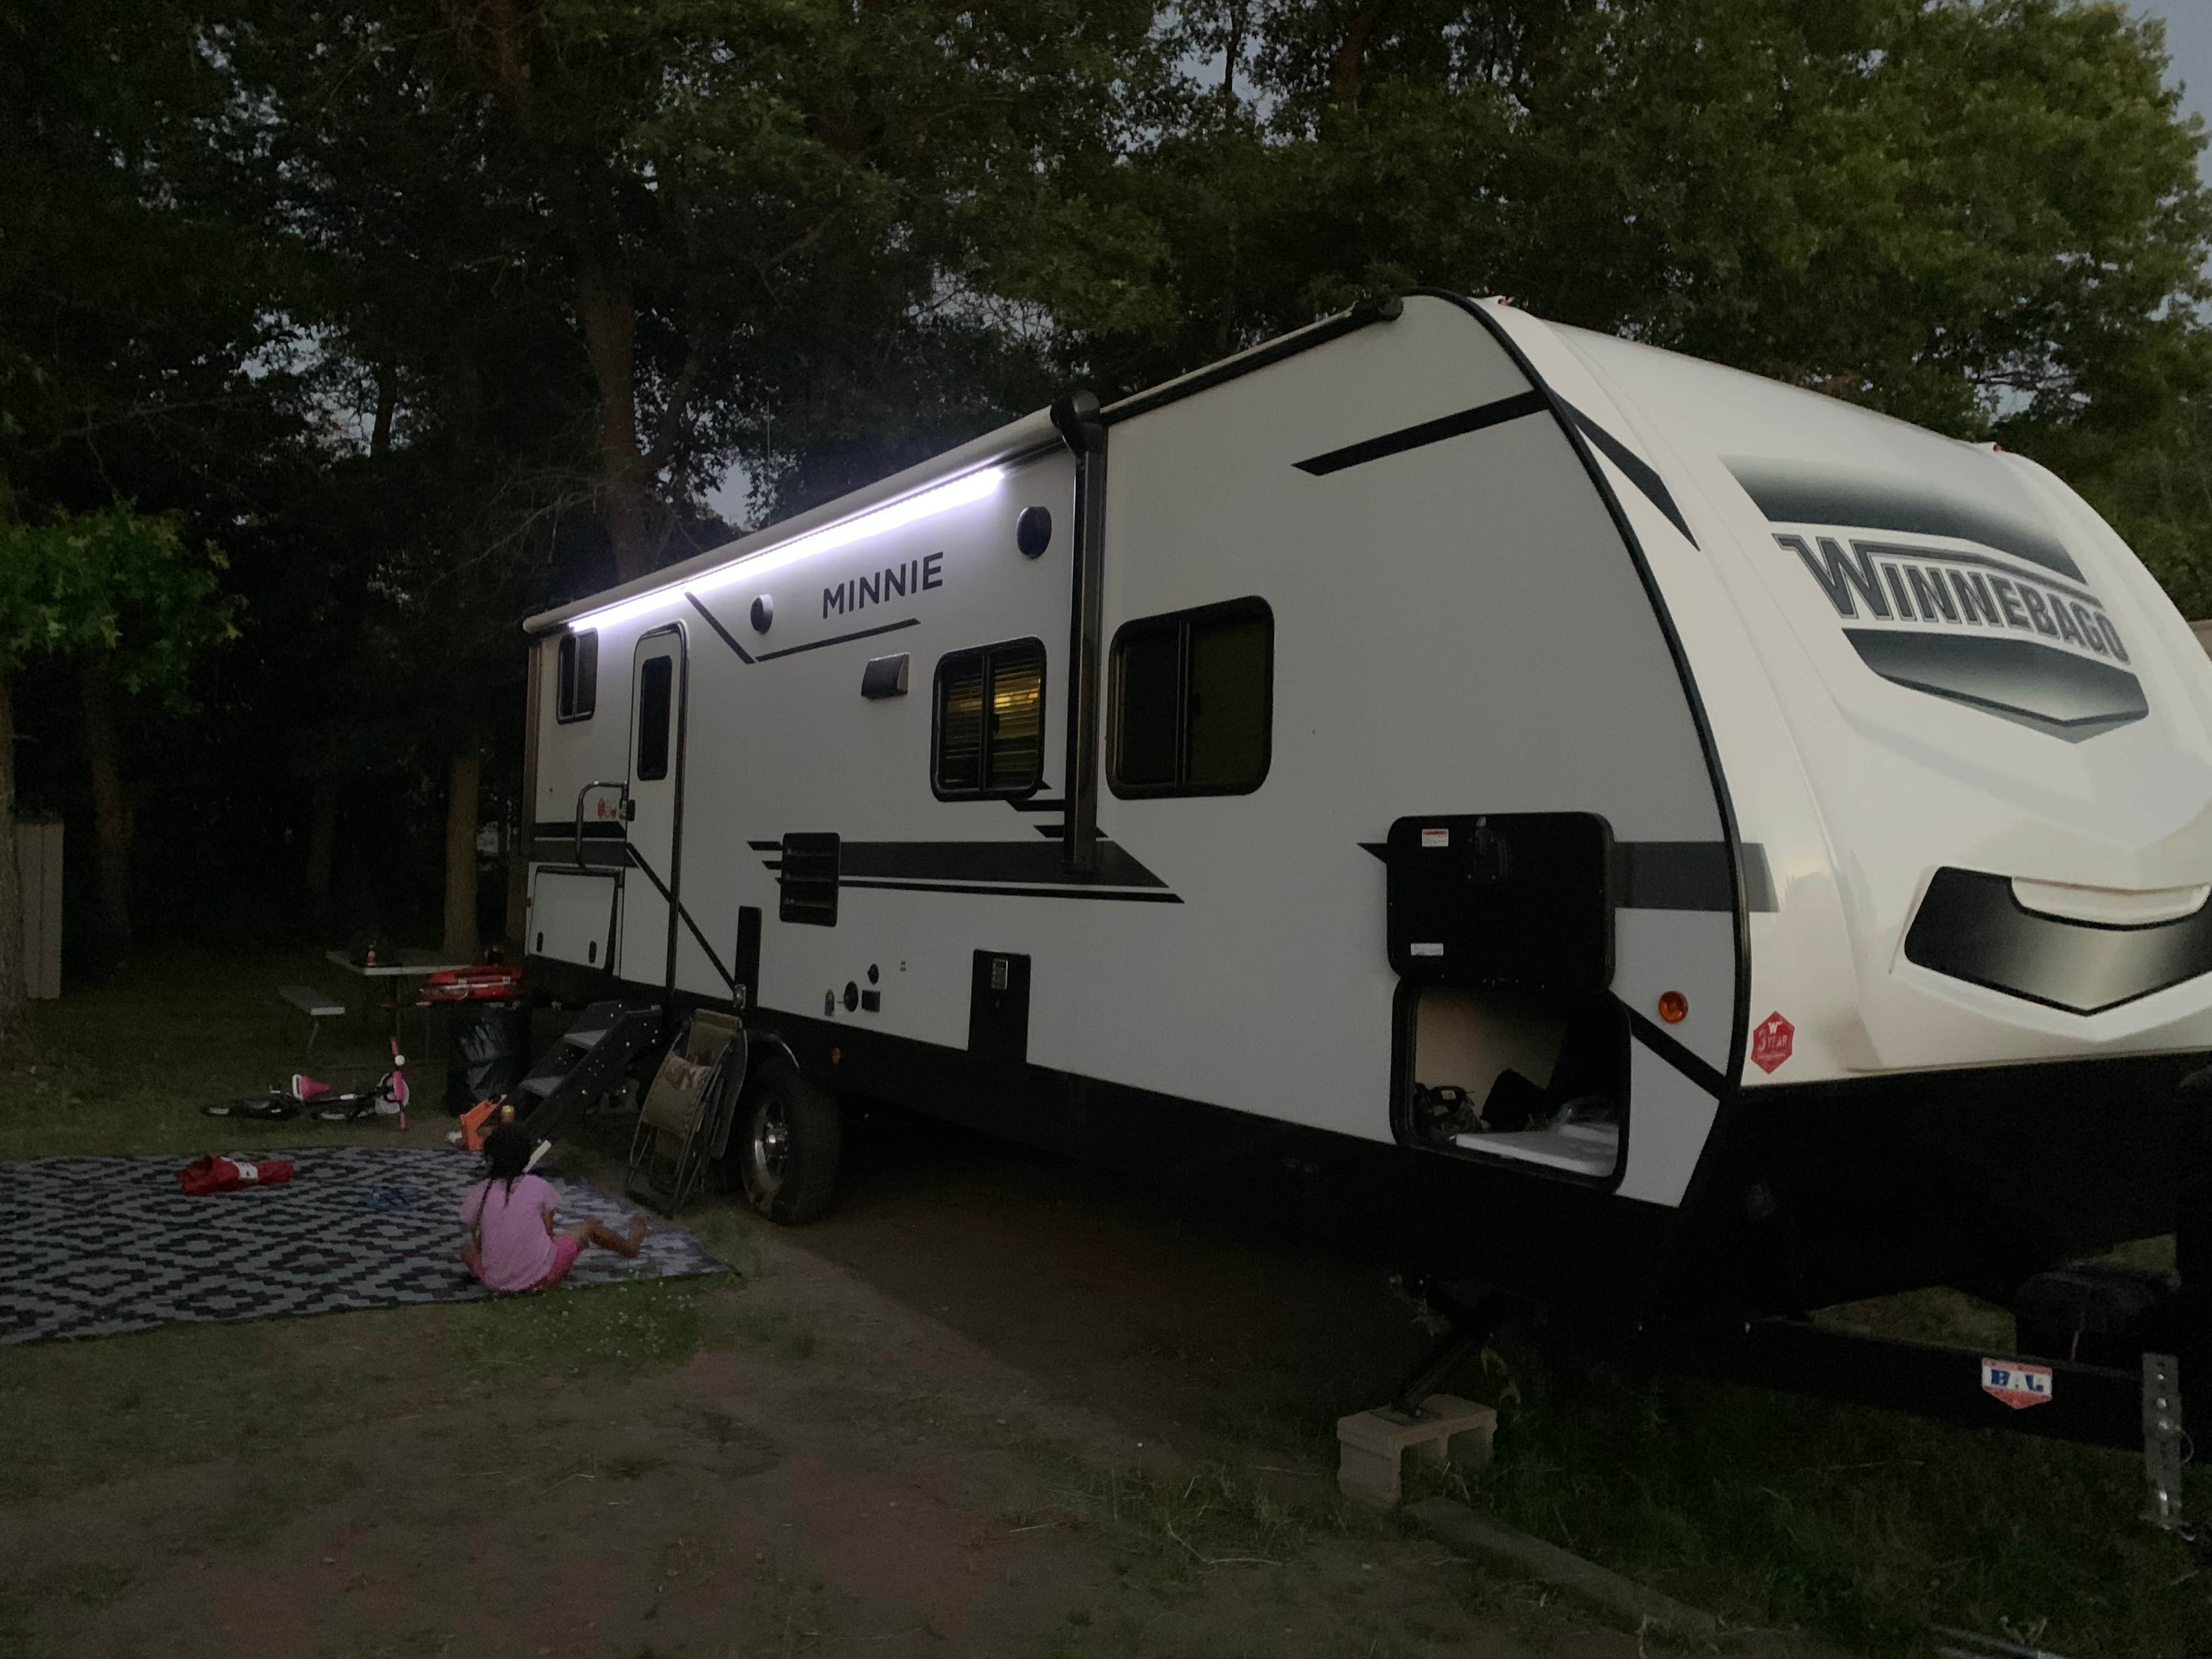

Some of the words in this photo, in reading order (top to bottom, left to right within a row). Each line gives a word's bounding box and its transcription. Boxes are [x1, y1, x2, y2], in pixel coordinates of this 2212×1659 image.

[823, 551, 943, 619] MINNIE
[1773, 533, 2131, 664] WINNEBAGO
[1991, 1369, 2044, 1392] BAL
